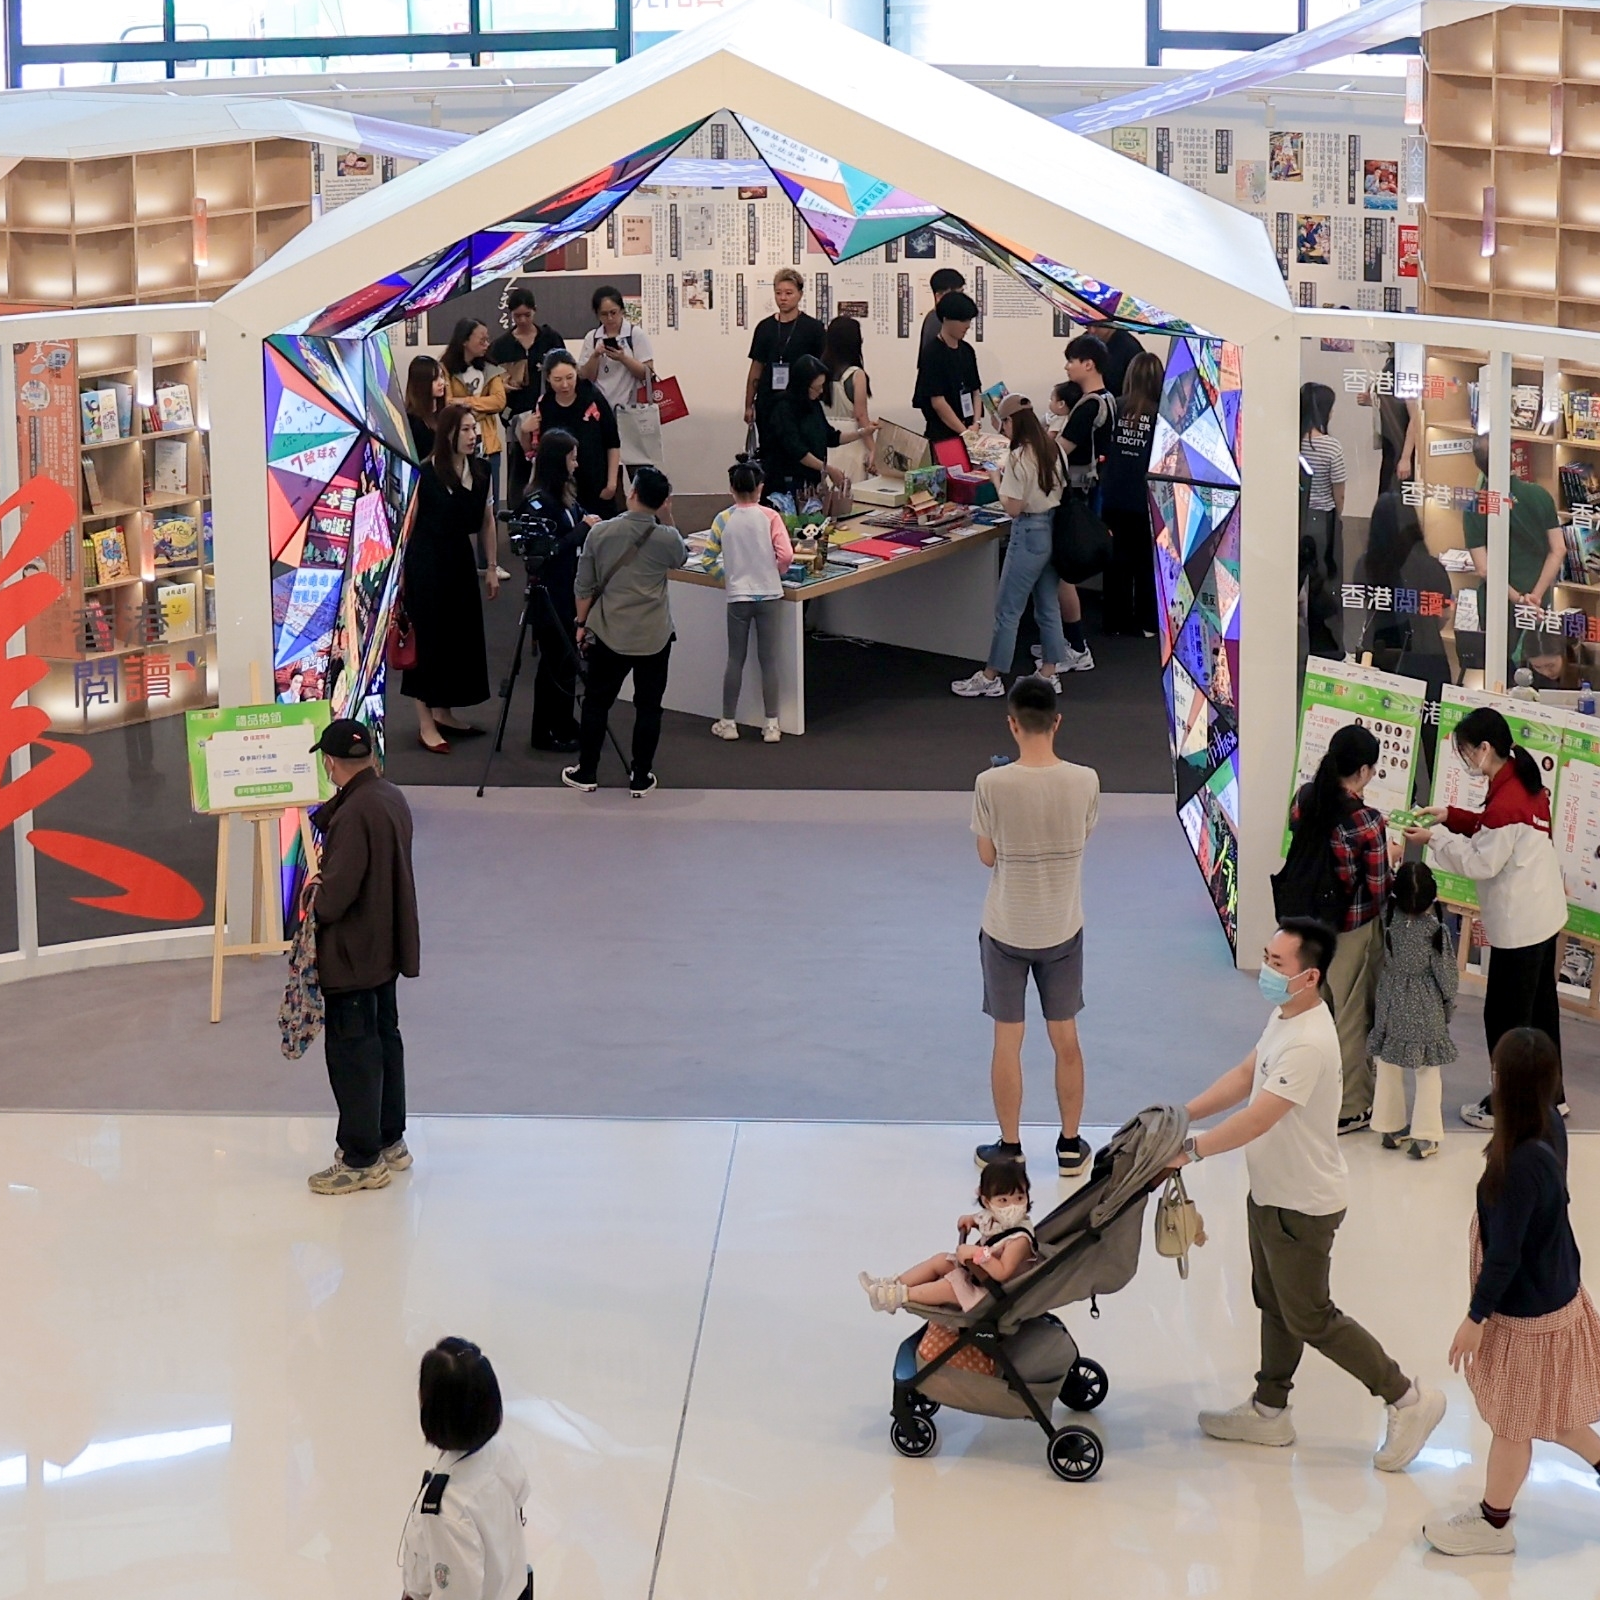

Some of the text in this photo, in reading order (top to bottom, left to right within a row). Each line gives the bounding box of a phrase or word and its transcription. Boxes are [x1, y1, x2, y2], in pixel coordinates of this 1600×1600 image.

[1342, 368, 1447, 402] 香港閱讀
[1118, 419, 1151, 432] BETER
[1122, 428, 1144, 439] WITH
[1117, 435, 1148, 448] EDCITY
[290, 446, 338, 473] 7號球衣
[320, 487, 357, 512] 一本書
[1400, 480, 1504, 518] 香港閱讀
[1340, 582, 1445, 619] 香港閱讀
[72, 598, 170, 653] 香港
[73, 654, 172, 713] 閱讀
[235, 711, 283, 728] 禮品換領
